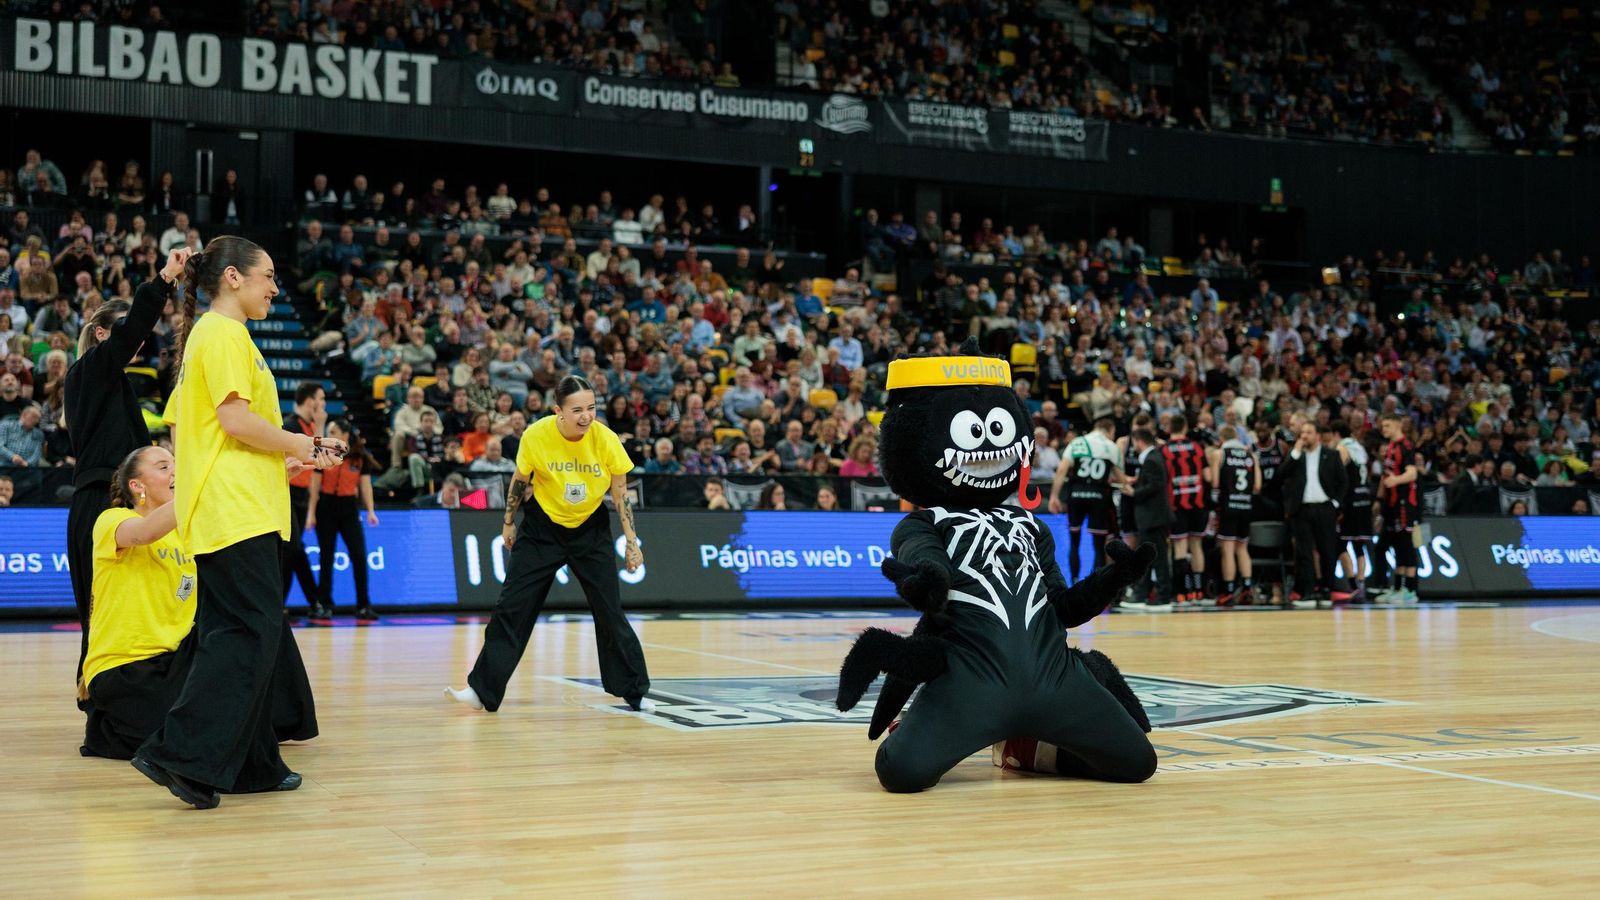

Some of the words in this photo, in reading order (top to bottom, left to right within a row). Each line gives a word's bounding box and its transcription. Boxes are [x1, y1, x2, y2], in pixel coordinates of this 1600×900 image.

[15, 17, 222, 88] BILBAO
[242, 38, 439, 106] BASKET
[500, 75, 560, 102] IMQ
[584, 76, 697, 112] Conservas
[700, 87, 809, 122] Cusumano
[942, 356, 1006, 384] vueling
[547, 457, 602, 478] vueling
[1077, 457, 1107, 480] 30
[1235, 468, 1248, 491] 3
[700, 544, 799, 573] Páginas
[802, 545, 852, 568] web
[1490, 543, 1564, 569] Páginas
[1564, 544, 1600, 564] web
